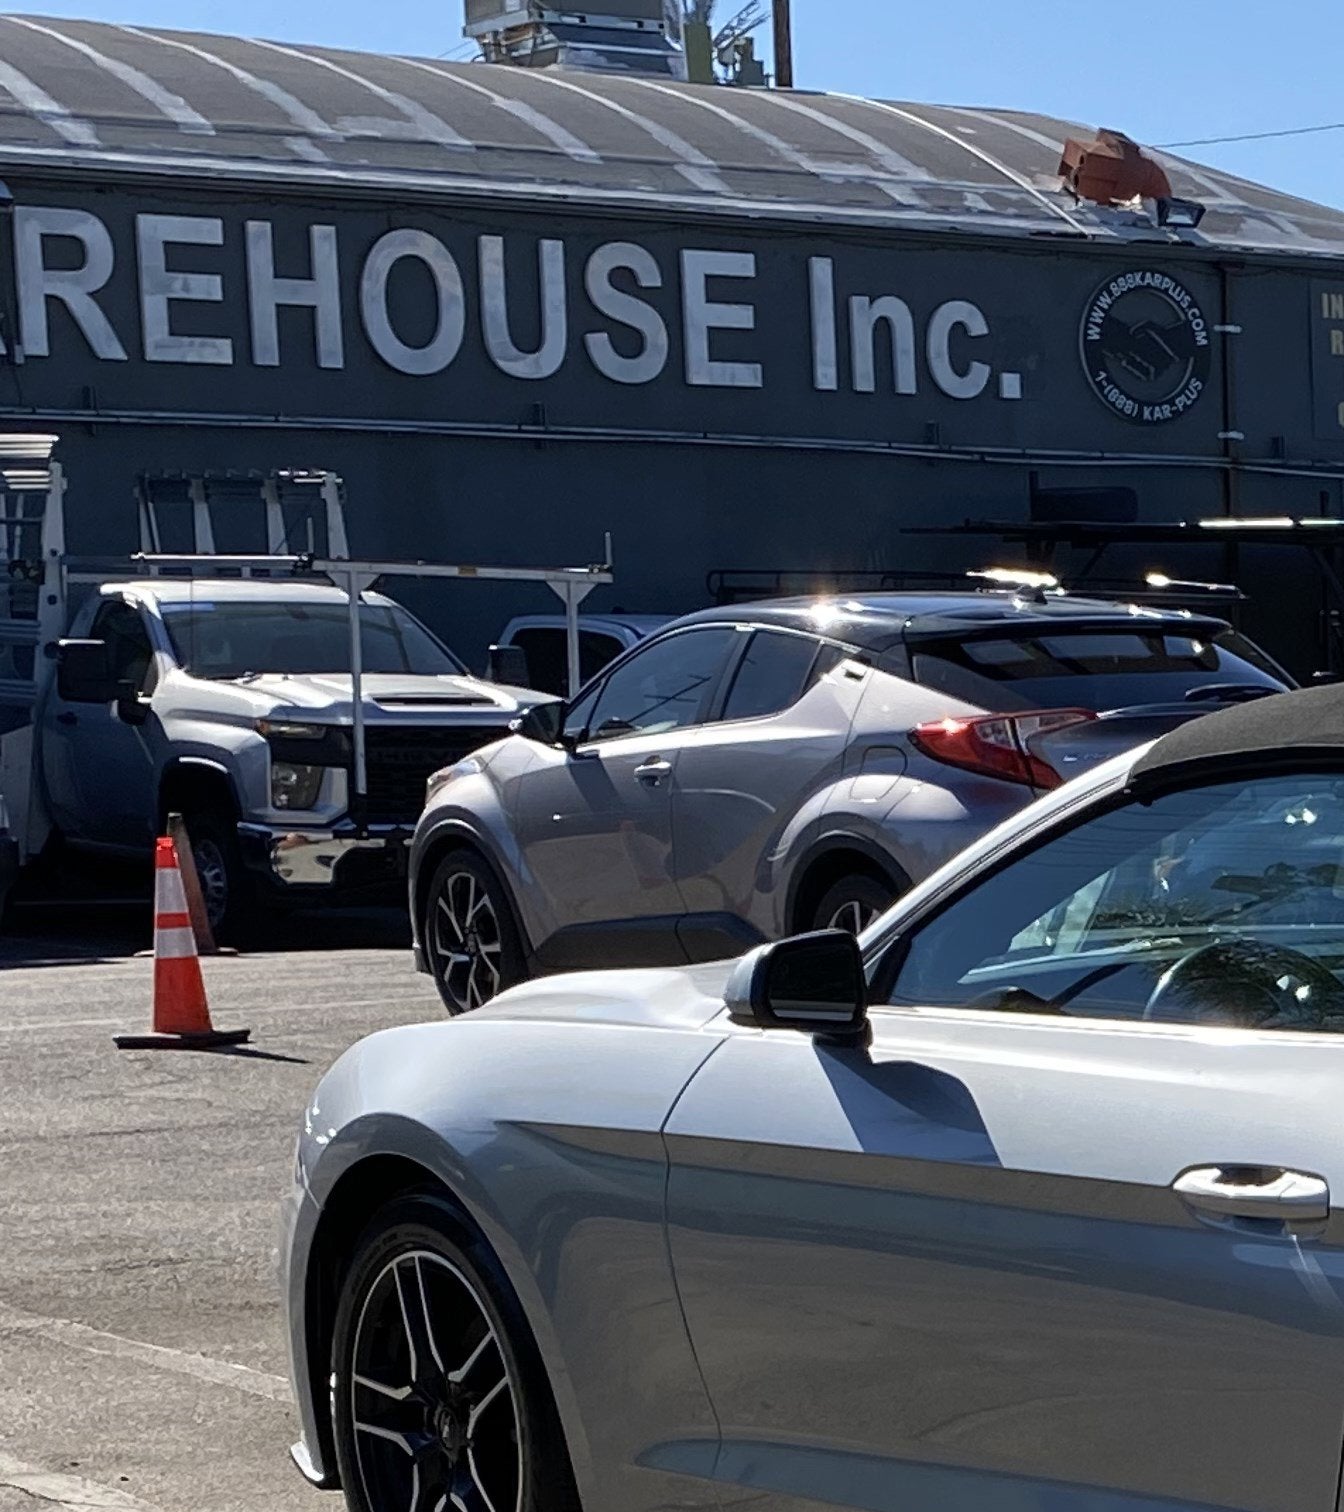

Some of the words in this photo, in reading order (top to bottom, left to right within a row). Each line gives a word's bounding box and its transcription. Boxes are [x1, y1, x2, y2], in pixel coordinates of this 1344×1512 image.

[0, 206, 763, 388] REHOUSE
[808, 256, 1021, 399] Inc.
[1087, 272, 1208, 346] WWW.888KARPLUS.COM
